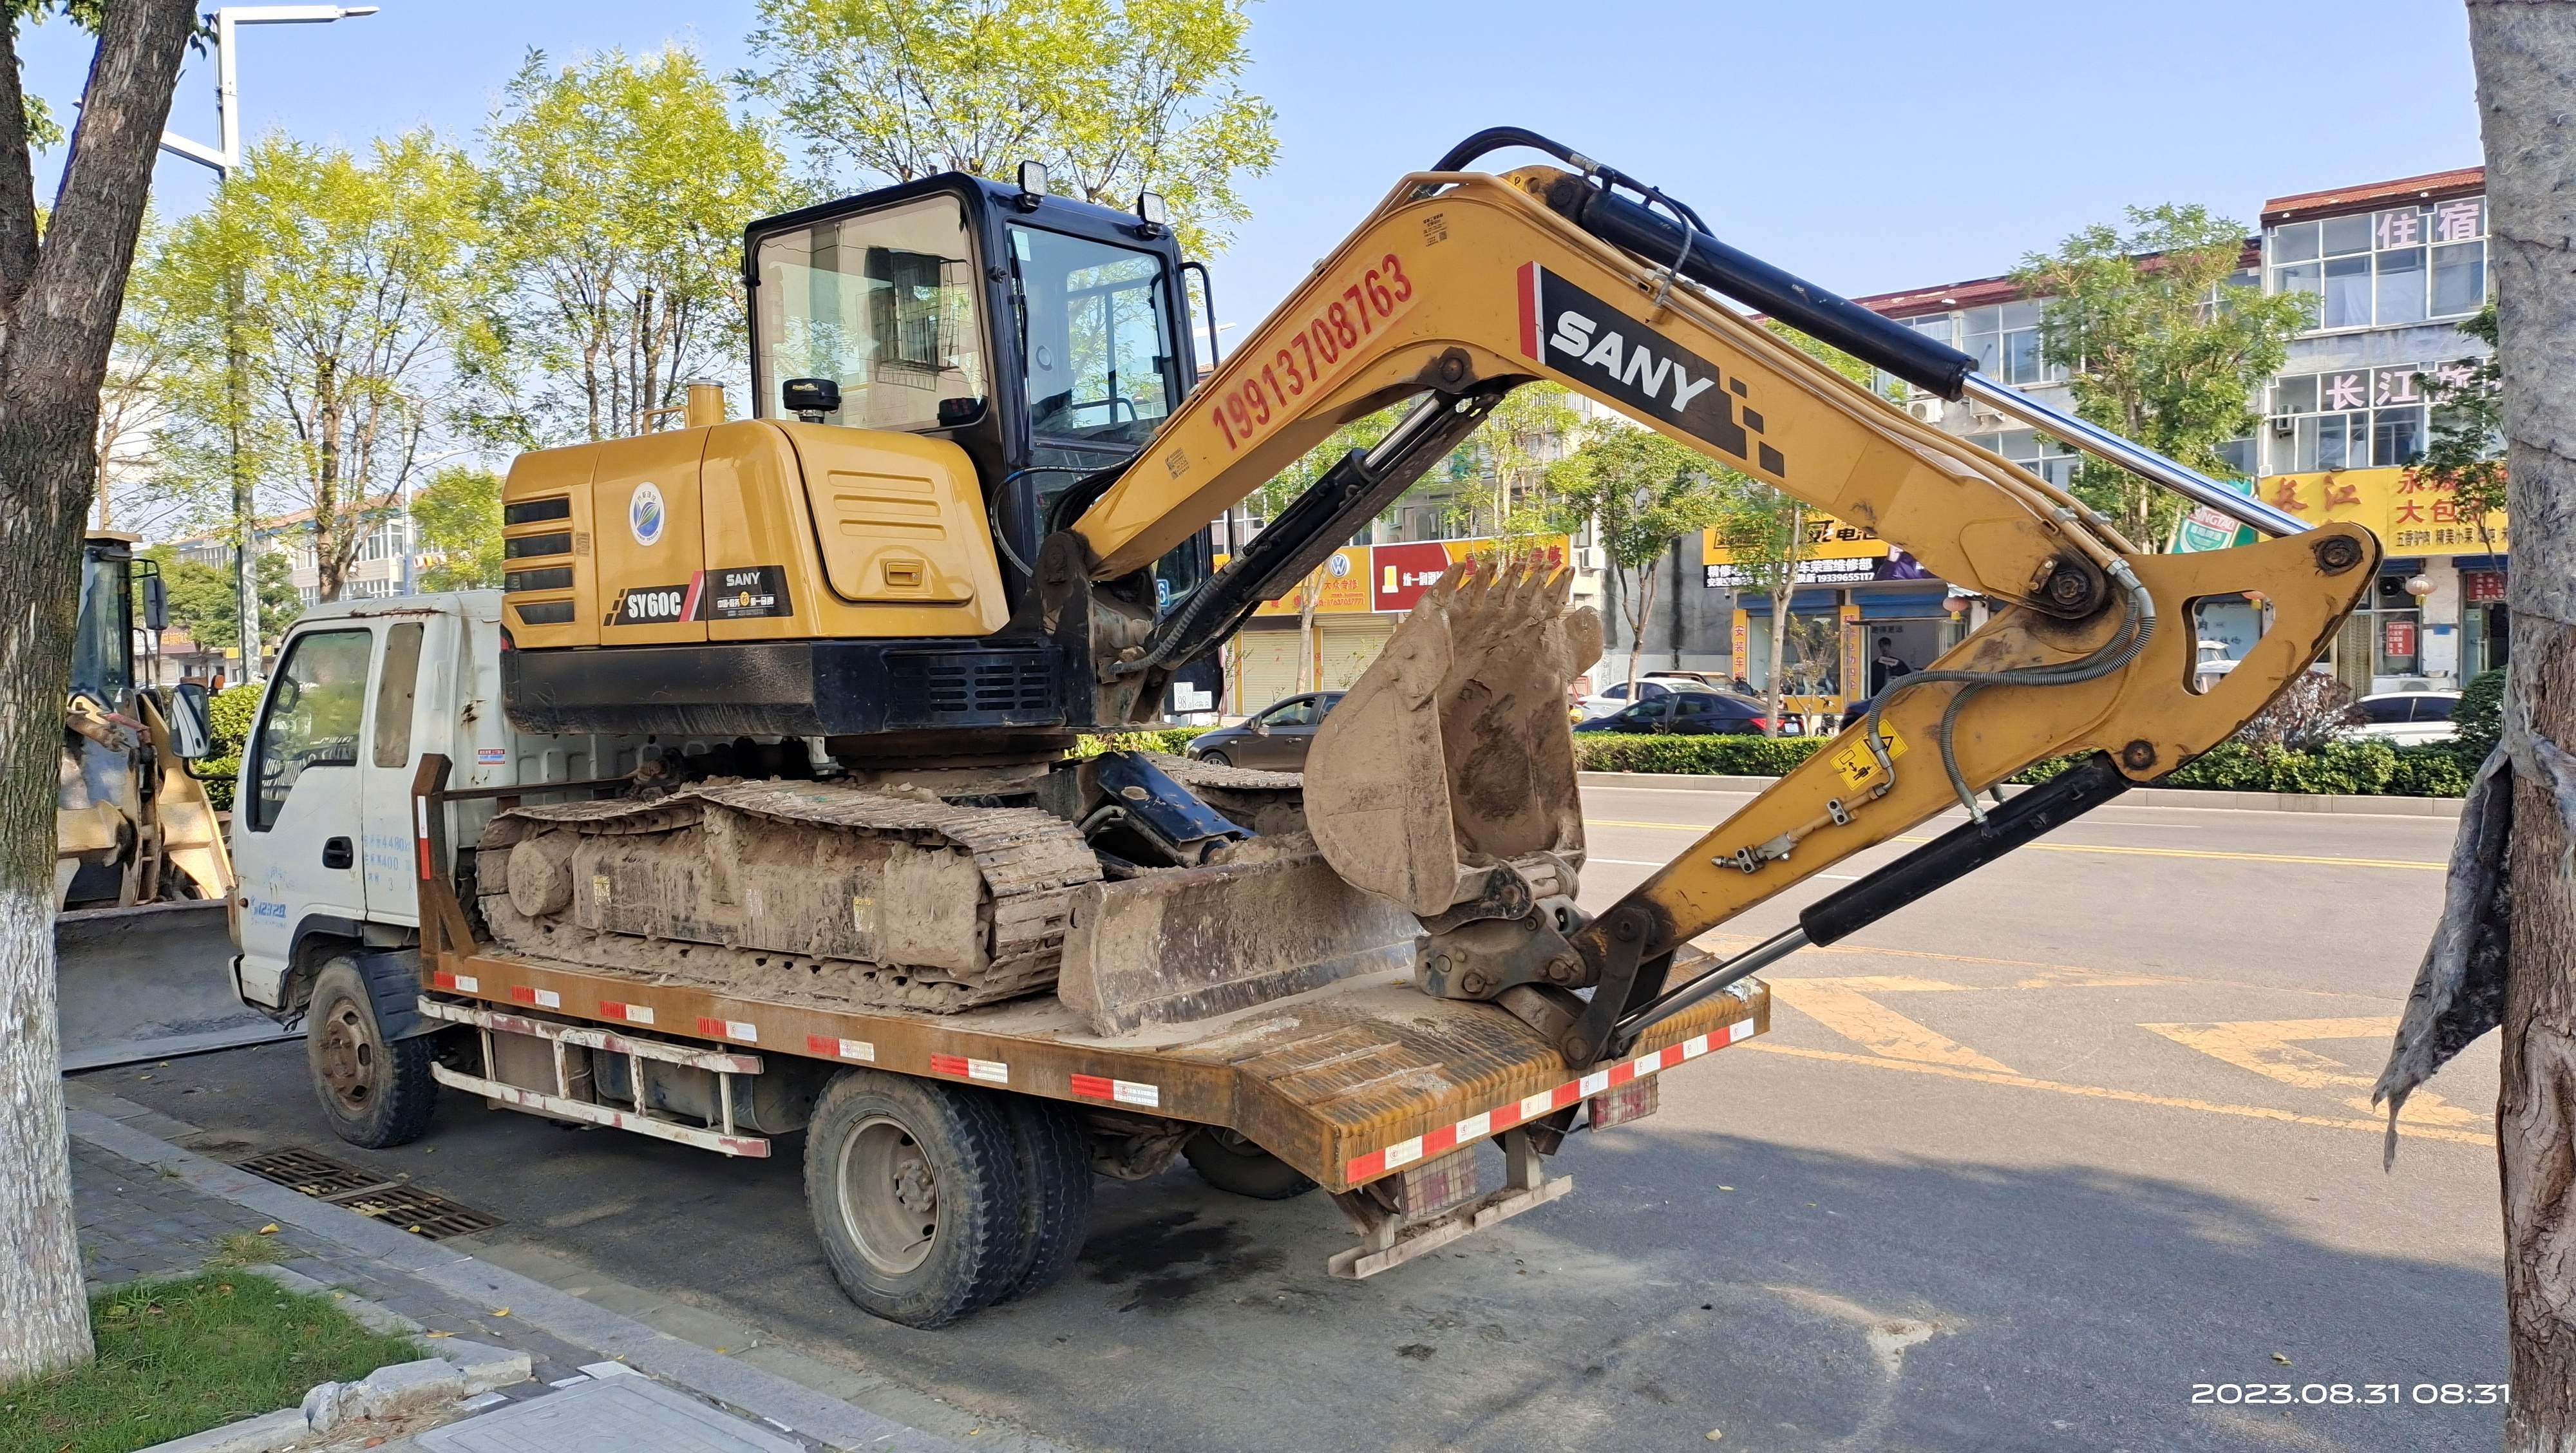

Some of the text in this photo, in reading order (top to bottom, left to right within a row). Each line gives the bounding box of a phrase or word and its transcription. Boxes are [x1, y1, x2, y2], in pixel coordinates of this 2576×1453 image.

[2377, 204, 2480, 249] 住宿
[1212, 254, 1412, 451] 19913708763
[1549, 310, 1715, 413] SANY
[2326, 364, 2502, 411] 长江旅
[2271, 475, 2362, 512] 长江
[726, 572, 760, 587] SANY
[1817, 573, 1875, 583] 19339655117
[628, 591, 681, 618] SY60C
